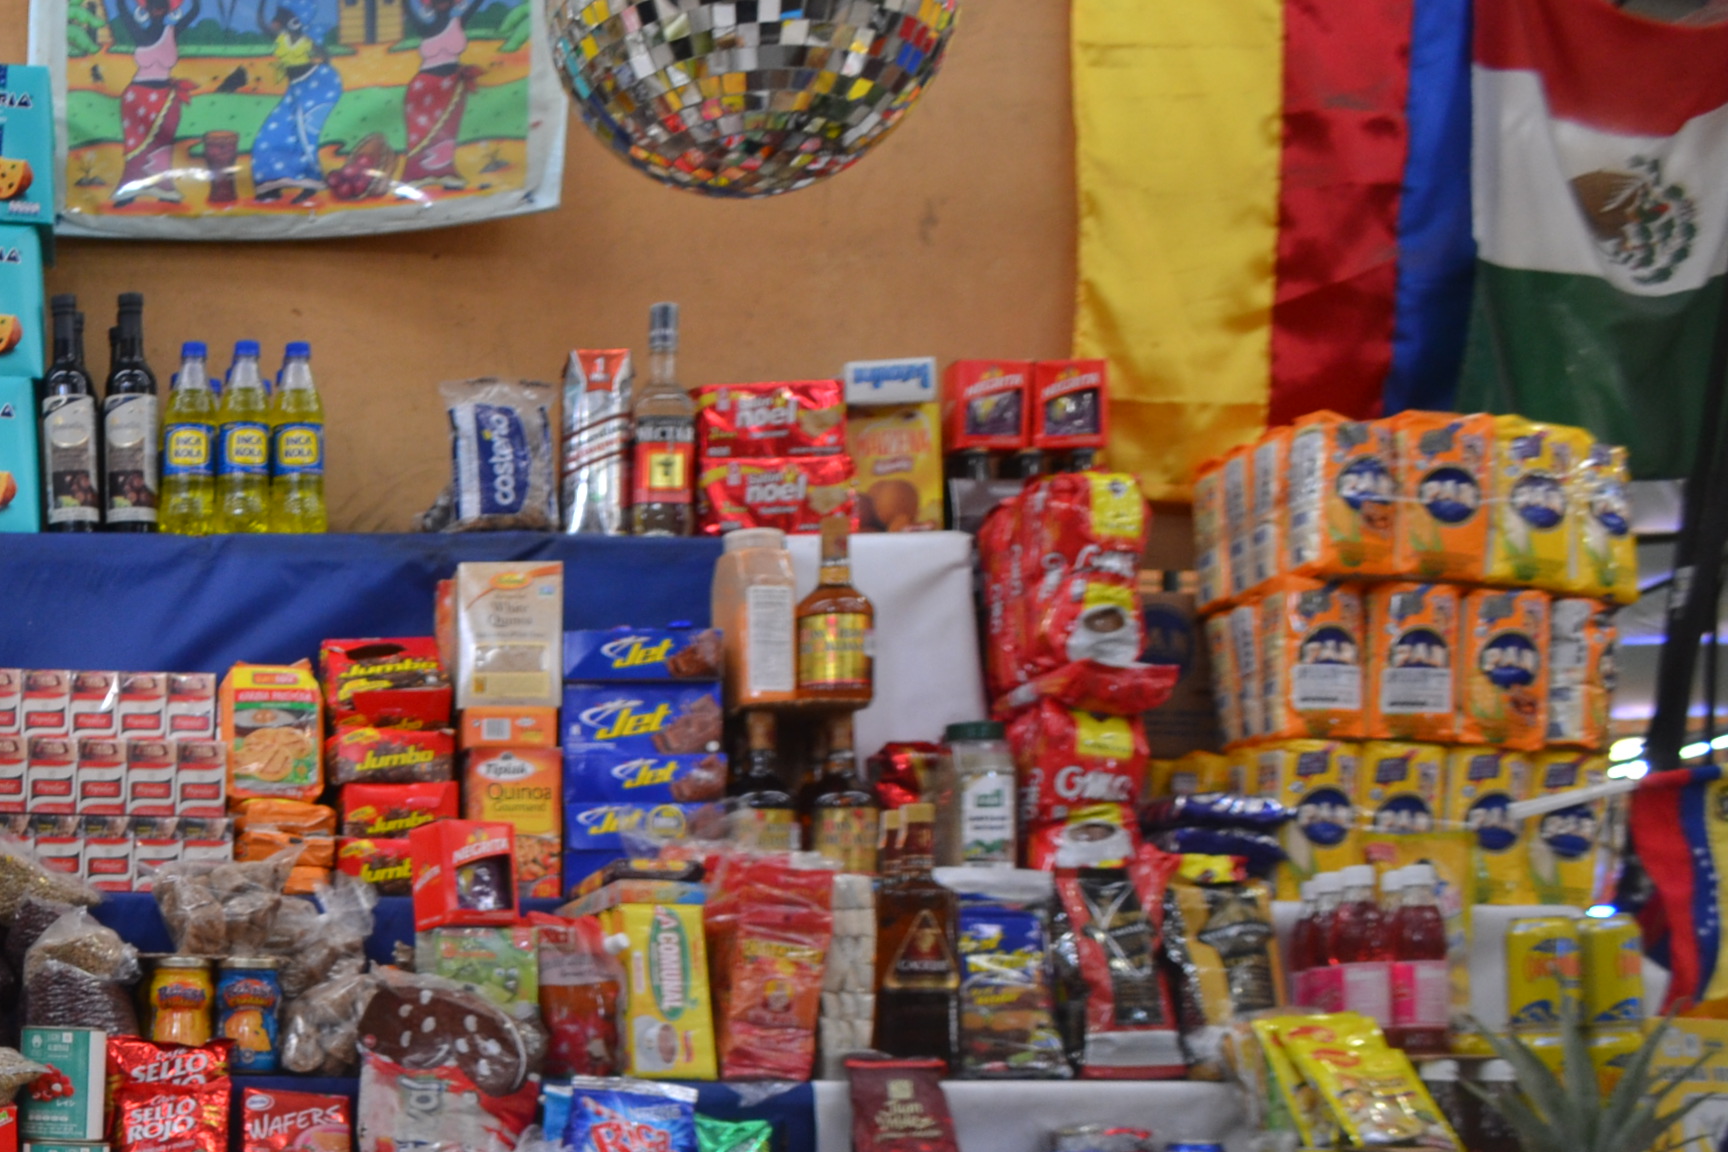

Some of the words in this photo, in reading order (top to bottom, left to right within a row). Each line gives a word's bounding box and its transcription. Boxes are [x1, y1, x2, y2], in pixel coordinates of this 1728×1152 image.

[735, 402, 798, 428] noel
[745, 477, 806, 503] noel
[612, 637, 674, 668] Jet
[594, 703, 671, 740] Jet
[355, 748, 435, 772] Jumbo
[622, 760, 679, 789] Jet
[487, 783, 552, 801] Quinoa
[360, 858, 412, 884] Jumb
[130, 1052, 209, 1084] SELLO
[130, 1097, 196, 1126] SELLO
[249, 1104, 342, 1140] WAFERS
[128, 1115, 196, 1144] ROJO
